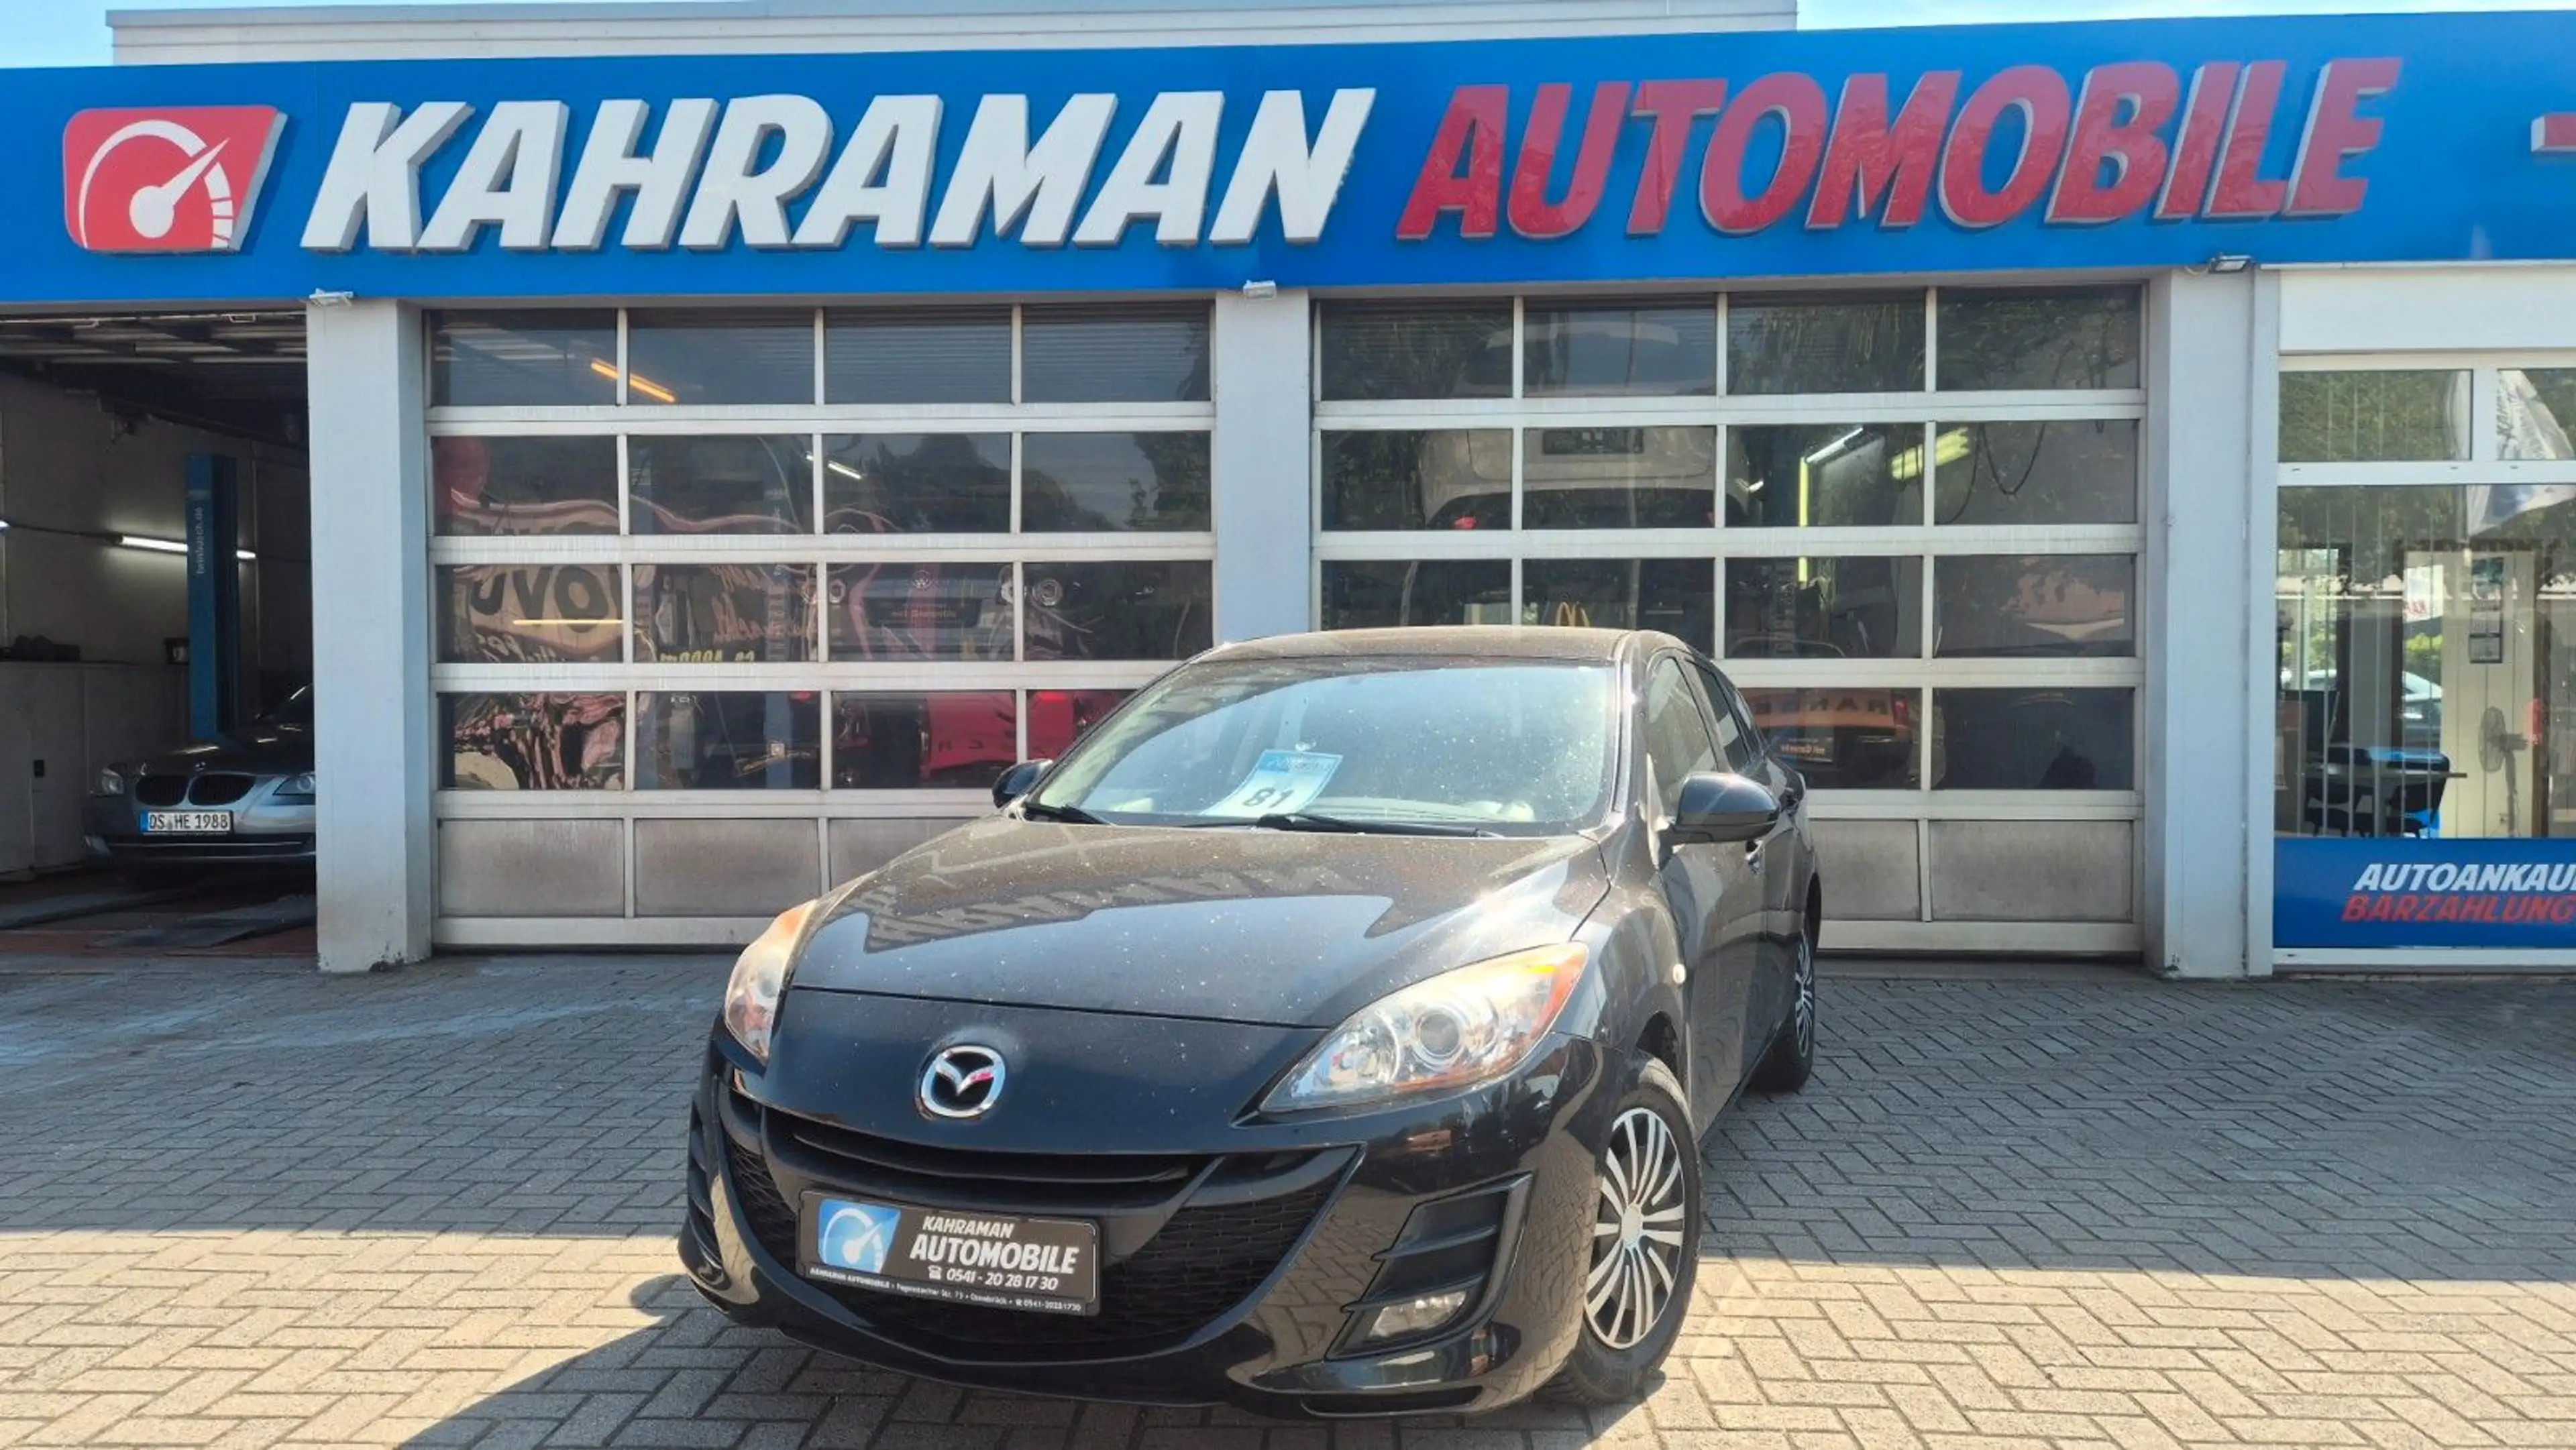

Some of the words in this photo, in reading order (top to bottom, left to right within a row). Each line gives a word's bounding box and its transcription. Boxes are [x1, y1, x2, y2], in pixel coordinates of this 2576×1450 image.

[300, 87, 1377, 254] KAHRAMAN
[1395, 57, 2402, 241] AUTOMOBILE
[149, 814, 165, 830] OS
[174, 814, 191, 830] HE
[195, 814, 228, 830] 1988
[2353, 862, 2576, 891] AUTOANKAU
[2342, 893, 2576, 922] BARZAHLUNG
[922, 1215, 1015, 1239] KAHRAMAN
[909, 1233, 1079, 1274] AUTOMOBILE
[946, 1268, 977, 1284] 0541
[984, 1272, 1004, 1286] 20
[1004, 1274, 1024, 1288] 28
[1025, 1275, 1039, 1289] 17
[1039, 1276, 1059, 1291] 30
